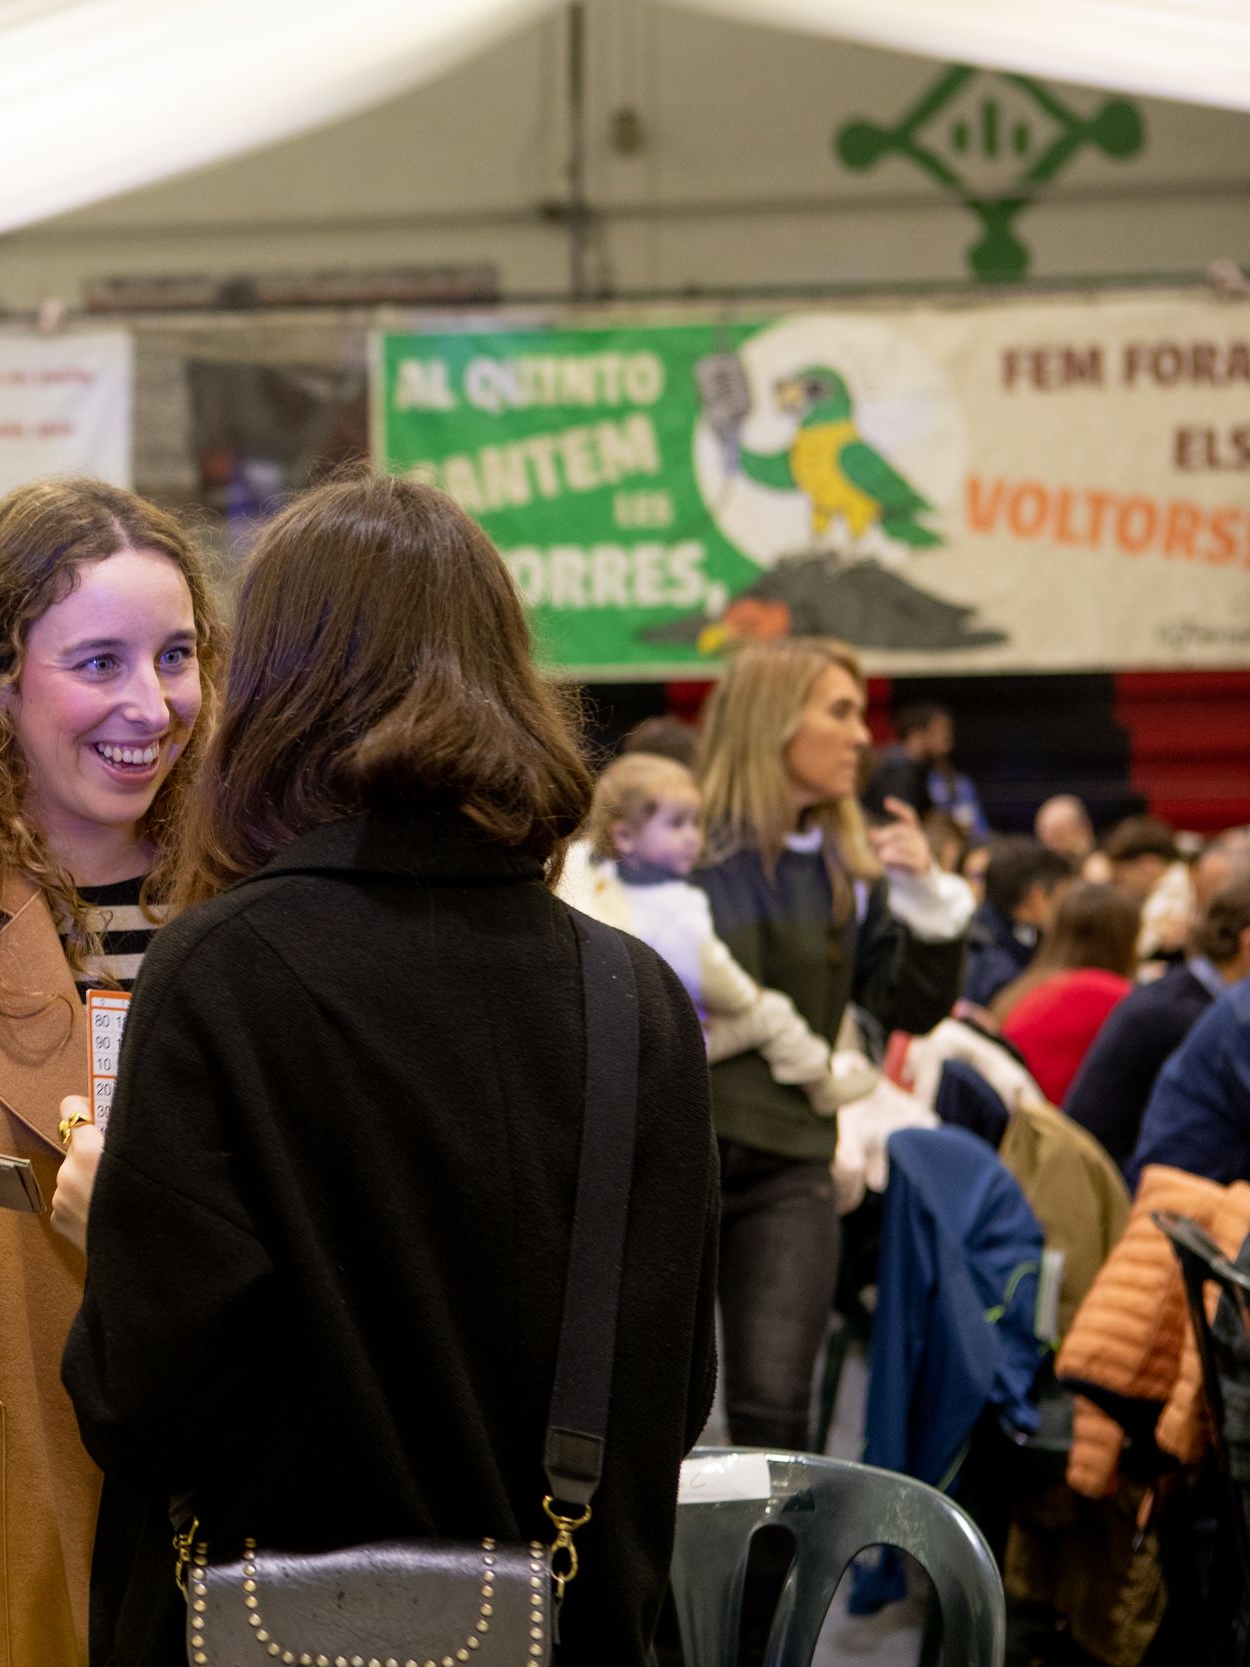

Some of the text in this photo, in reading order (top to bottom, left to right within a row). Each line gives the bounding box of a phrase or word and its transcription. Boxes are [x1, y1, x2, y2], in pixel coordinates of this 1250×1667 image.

[396, 351, 664, 414] AL QUINTO
[1002, 339, 1250, 392] FEM FORA
[406, 413, 661, 514] ANTEM
[1172, 425, 1250, 472] ELS
[965, 469, 1250, 571] VOLTORS
[502, 540, 728, 619] ORRES,
[95, 1014, 110, 1028] 80
[95, 1036, 111, 1049] 90
[96, 1058, 111, 1071] 10
[96, 1083, 111, 1096] 20
